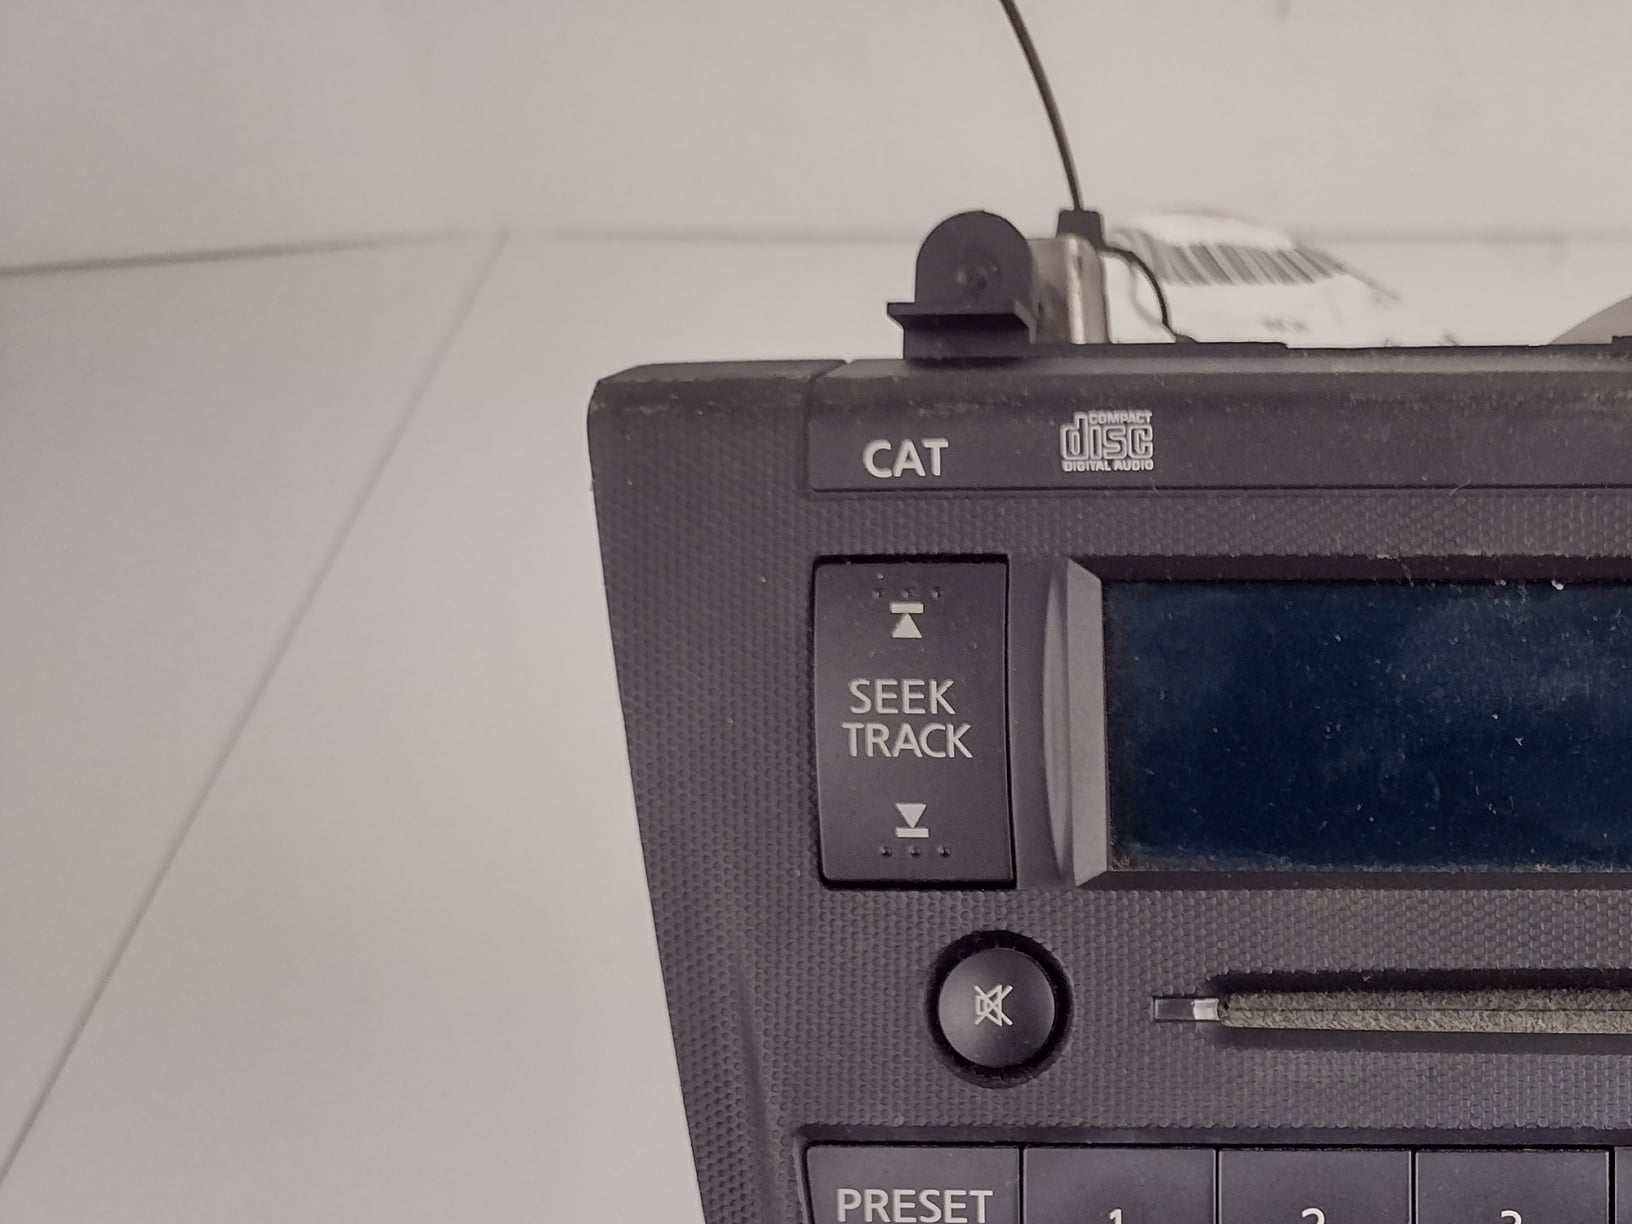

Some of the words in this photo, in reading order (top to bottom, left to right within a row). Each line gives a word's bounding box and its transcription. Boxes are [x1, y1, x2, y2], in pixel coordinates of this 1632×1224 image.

[1087, 410, 1152, 425] COMPACT
[863, 438, 948, 478] CAT
[1062, 460, 1110, 471] DIGITAL
[1113, 459, 1153, 470] AUDIO
[849, 678, 955, 715] SEEK
[842, 722, 973, 758] TRACK
[836, 1188, 993, 1223] PRESET
